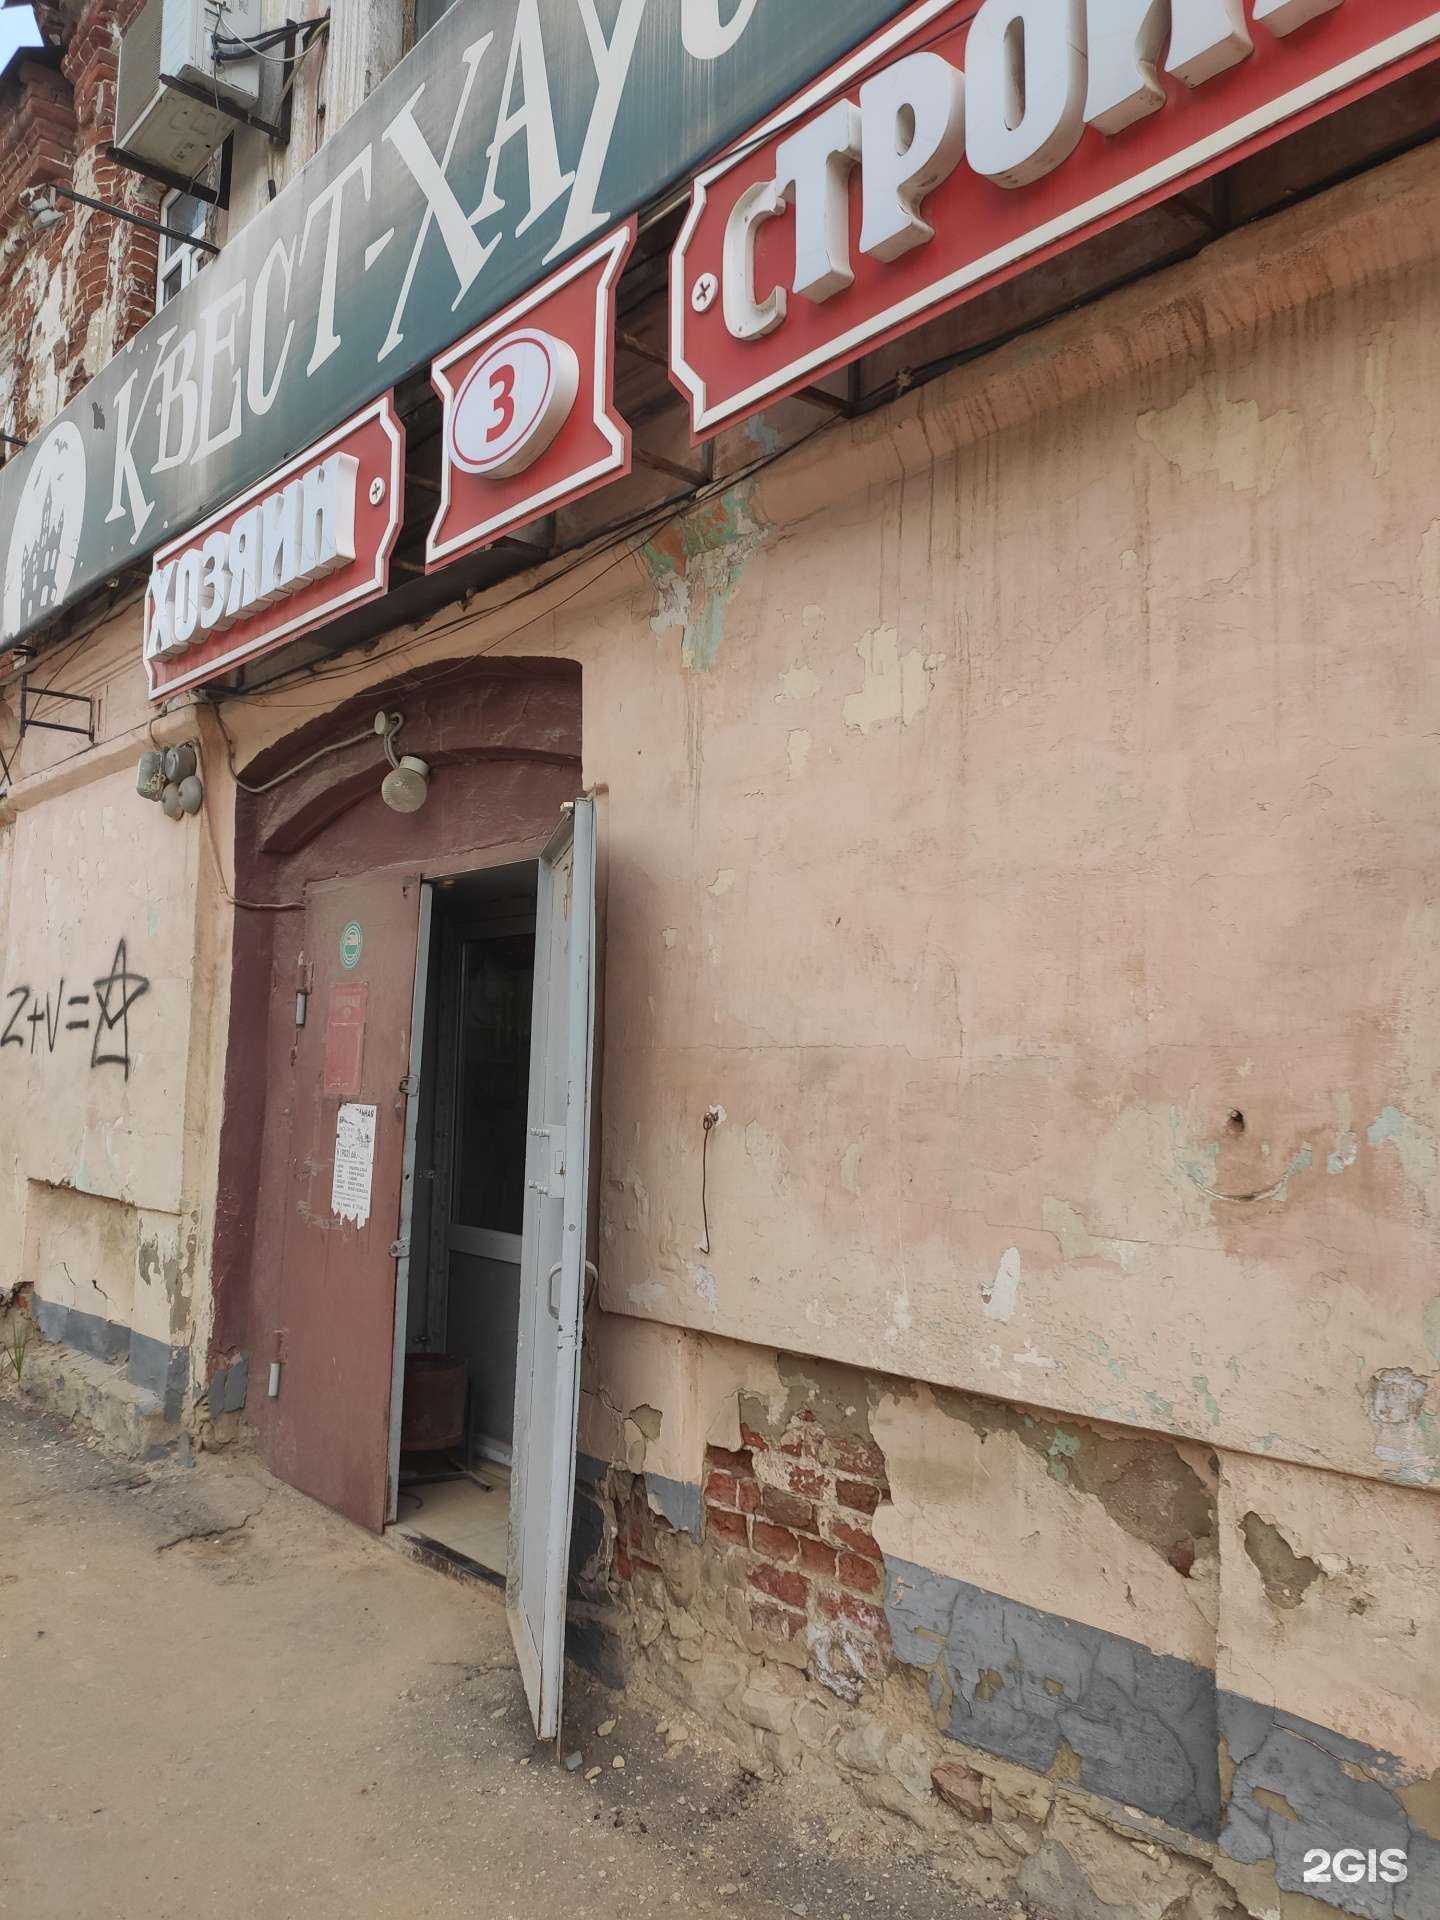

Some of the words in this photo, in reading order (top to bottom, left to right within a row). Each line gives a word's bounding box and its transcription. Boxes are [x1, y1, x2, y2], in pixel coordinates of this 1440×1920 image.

[105, 0, 757, 546] КВЕСТ-ХАУ
[723, 0, 1344, 342] СТРО
[147, 452, 358, 662] ХОЗЯИН
